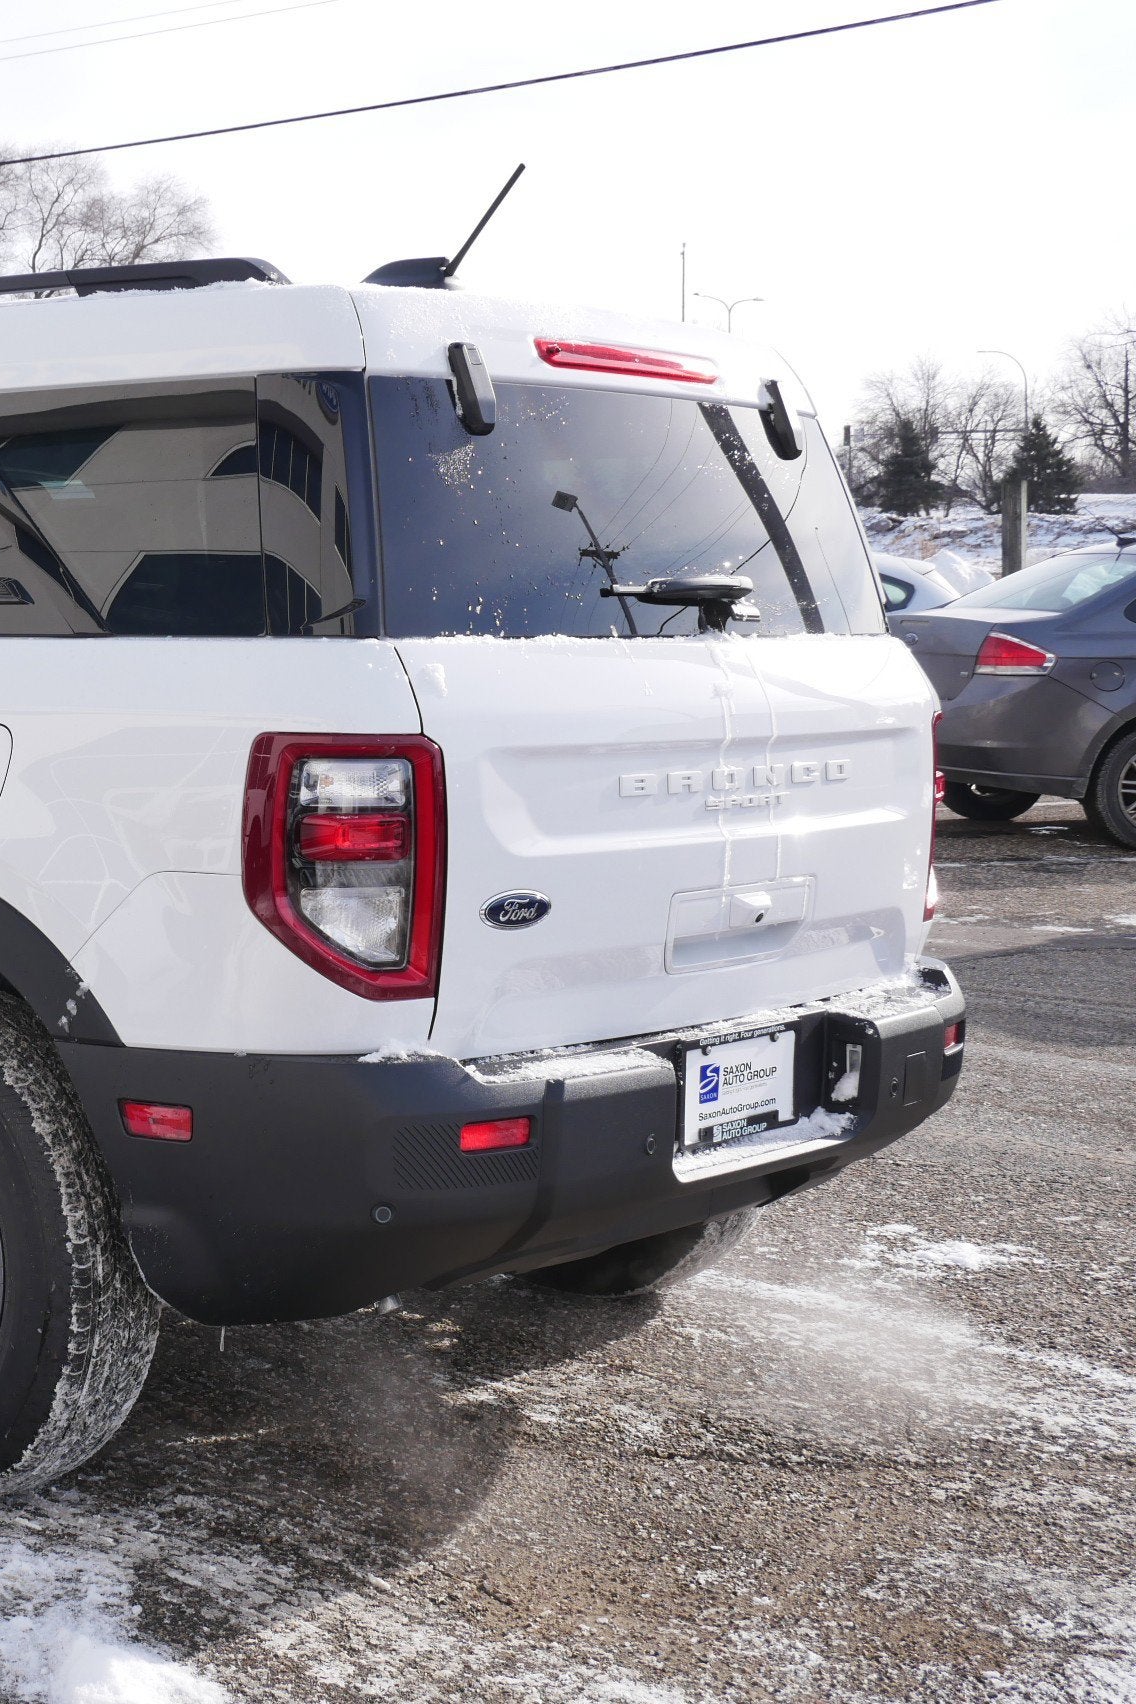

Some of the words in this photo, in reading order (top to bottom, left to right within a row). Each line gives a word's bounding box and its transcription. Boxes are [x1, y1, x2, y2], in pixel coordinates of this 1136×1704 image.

[619, 759, 852, 797] BRONCO
[704, 792, 791, 811] SPORT
[500, 898, 539, 922] Ford
[699, 1036, 720, 1046] Getting
[722, 1073, 745, 1087] AUTO
[746, 1066, 778, 1082] GROUP
[723, 1062, 752, 1077] SAXON
[700, 1092, 718, 1101] SAXON
[698, 1097, 777, 1122] SaxonAutoGroup.com
[722, 1119, 747, 1132] SAXON
[722, 1128, 741, 1140] AUTO
[742, 1122, 767, 1135] GROUP
